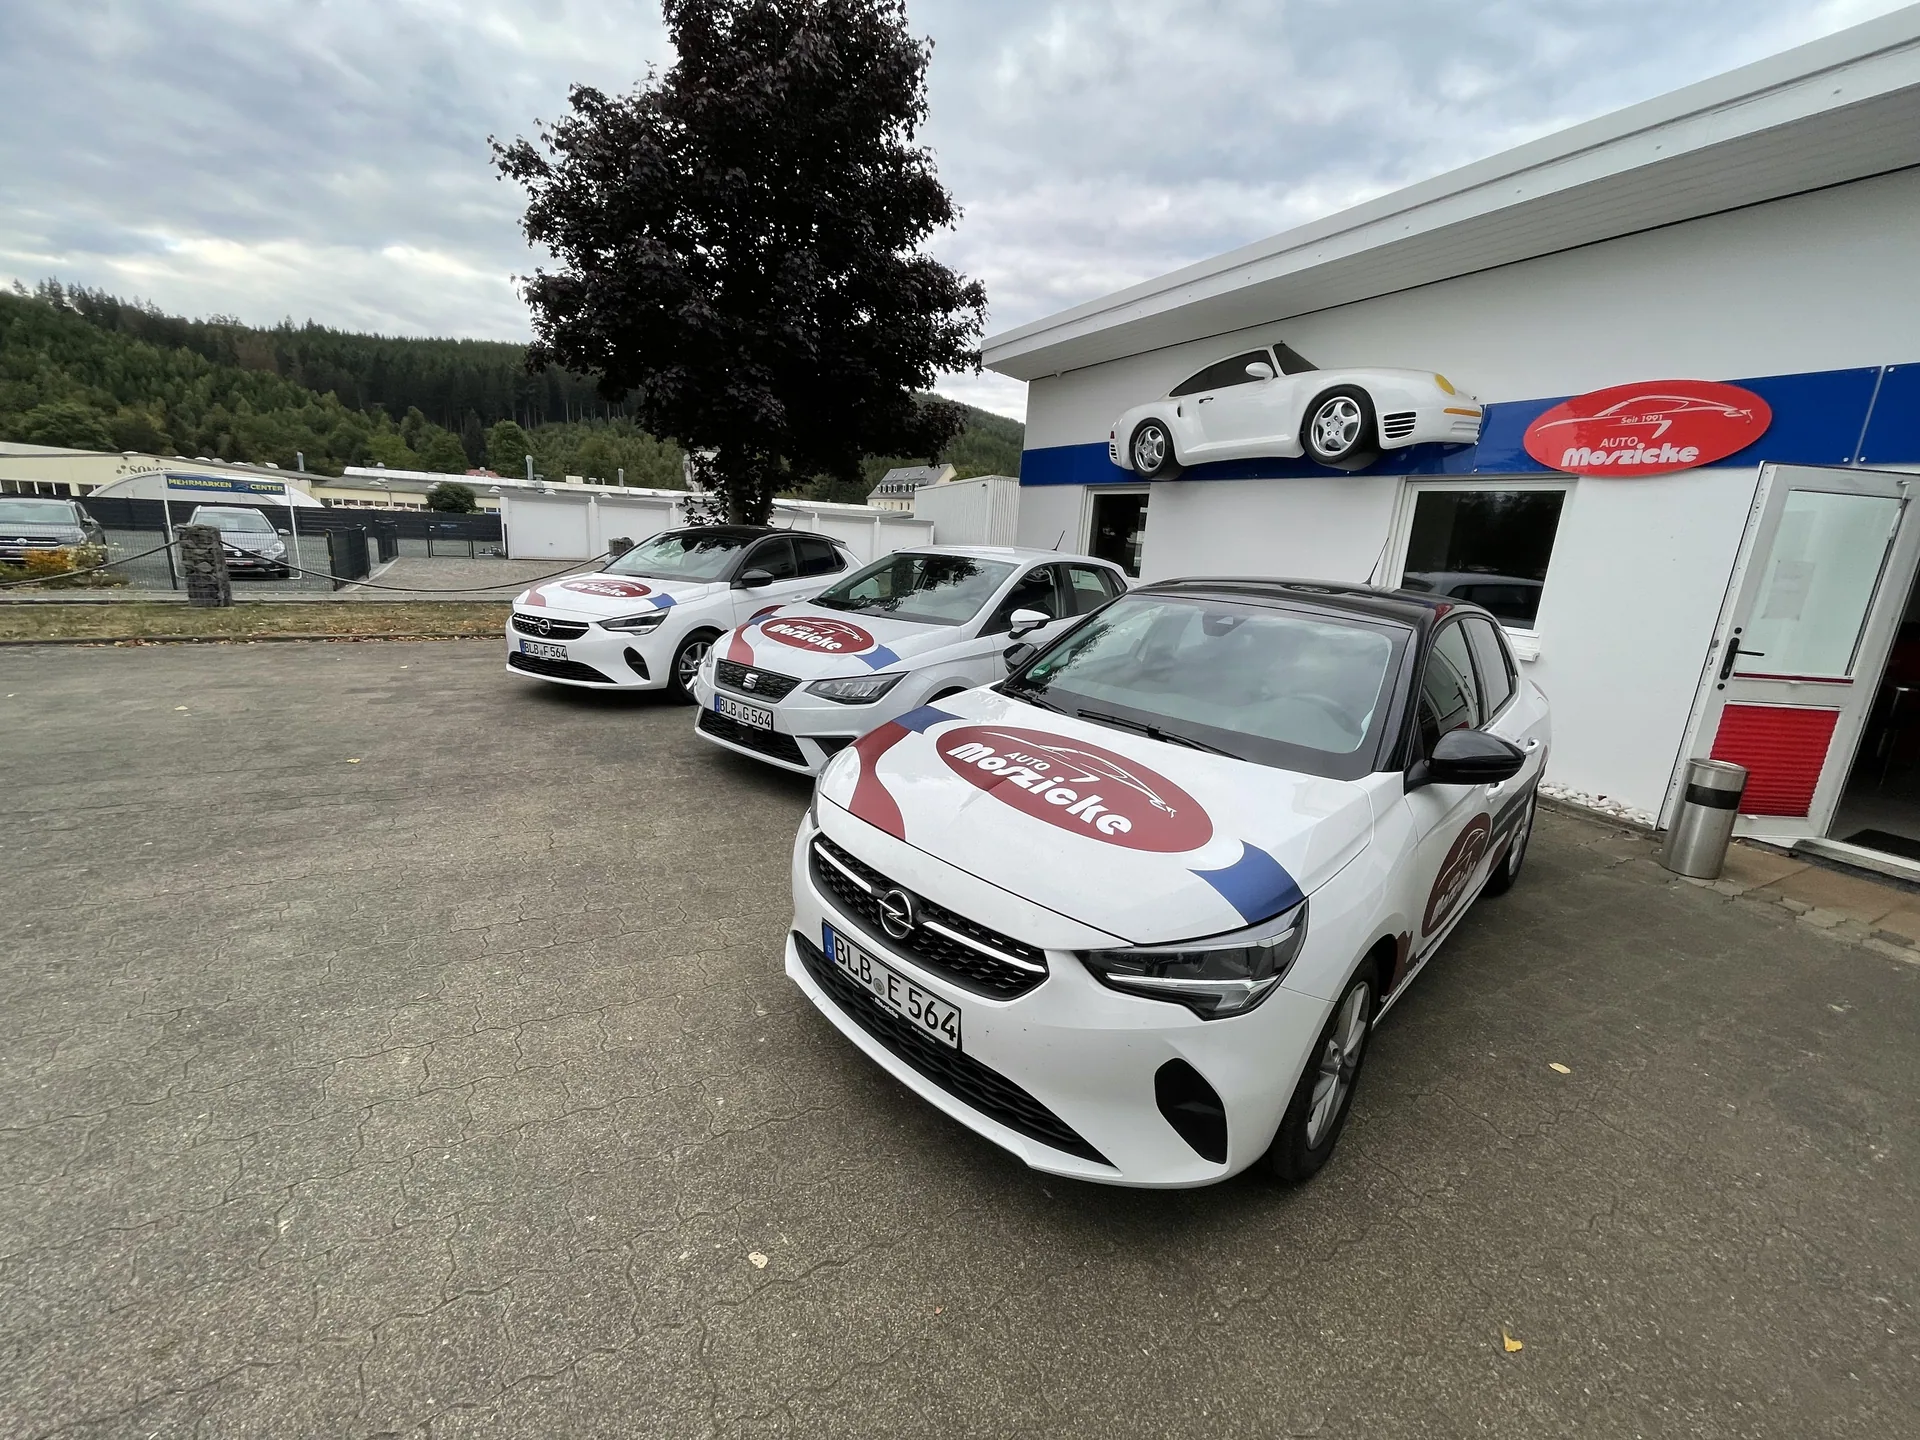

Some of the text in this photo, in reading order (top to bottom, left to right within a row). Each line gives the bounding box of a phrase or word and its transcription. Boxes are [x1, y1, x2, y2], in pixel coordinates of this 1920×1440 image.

[1620, 414, 1663, 424] Seit 1991
[1599, 436, 1639, 448] AUTO
[168, 478, 284, 492] MEHRMARKEN CENTER
[524, 642, 539, 655] BLB
[550, 647, 567, 659] 564
[719, 698, 771, 728] BLB G 564
[1004, 752, 1051, 771] AUTO
[834, 935, 873, 985] BLB
[887, 973, 902, 1008] E
[908, 986, 957, 1042] 564
